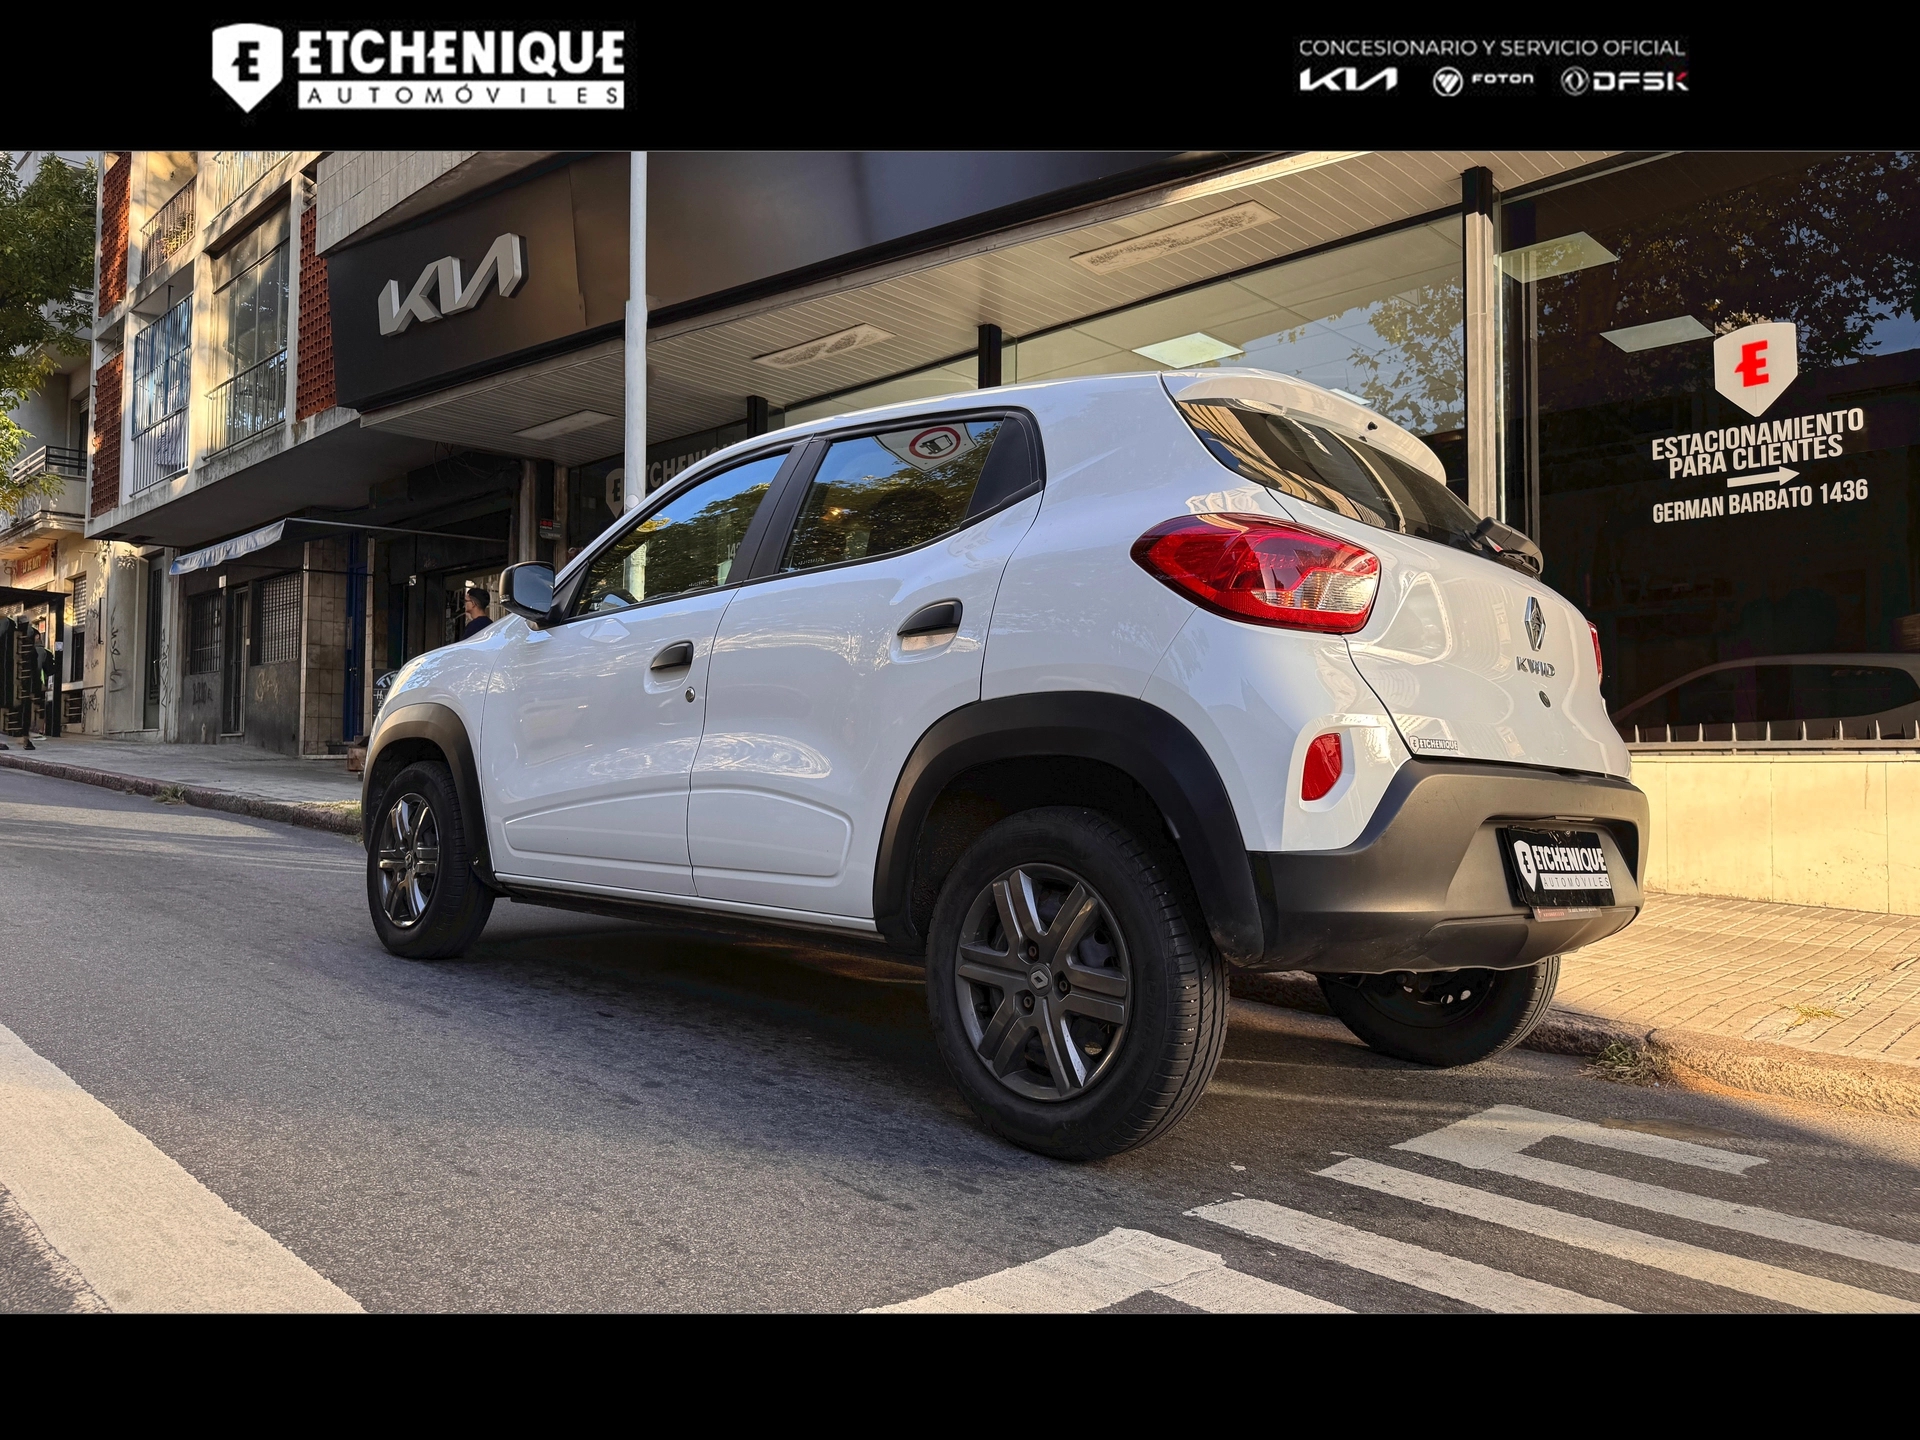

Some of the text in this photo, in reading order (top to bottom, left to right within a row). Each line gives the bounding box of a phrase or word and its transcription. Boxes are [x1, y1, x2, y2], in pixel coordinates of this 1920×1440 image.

[378, 232, 526, 337] KIA
[1734, 339, 1770, 388] E
[1651, 407, 1865, 461] ESTACIONAMIENTO
[1669, 434, 1844, 480] PARA CLIENTES
[1652, 478, 1869, 524] GERMAN BARBATO 1436
[1515, 656, 1556, 678] KWID
[1418, 738, 1459, 751] ETCHENIQUE
[1531, 845, 1607, 873] ETCHENIQUE
[1543, 875, 1610, 888] AUTOMÓVILES
